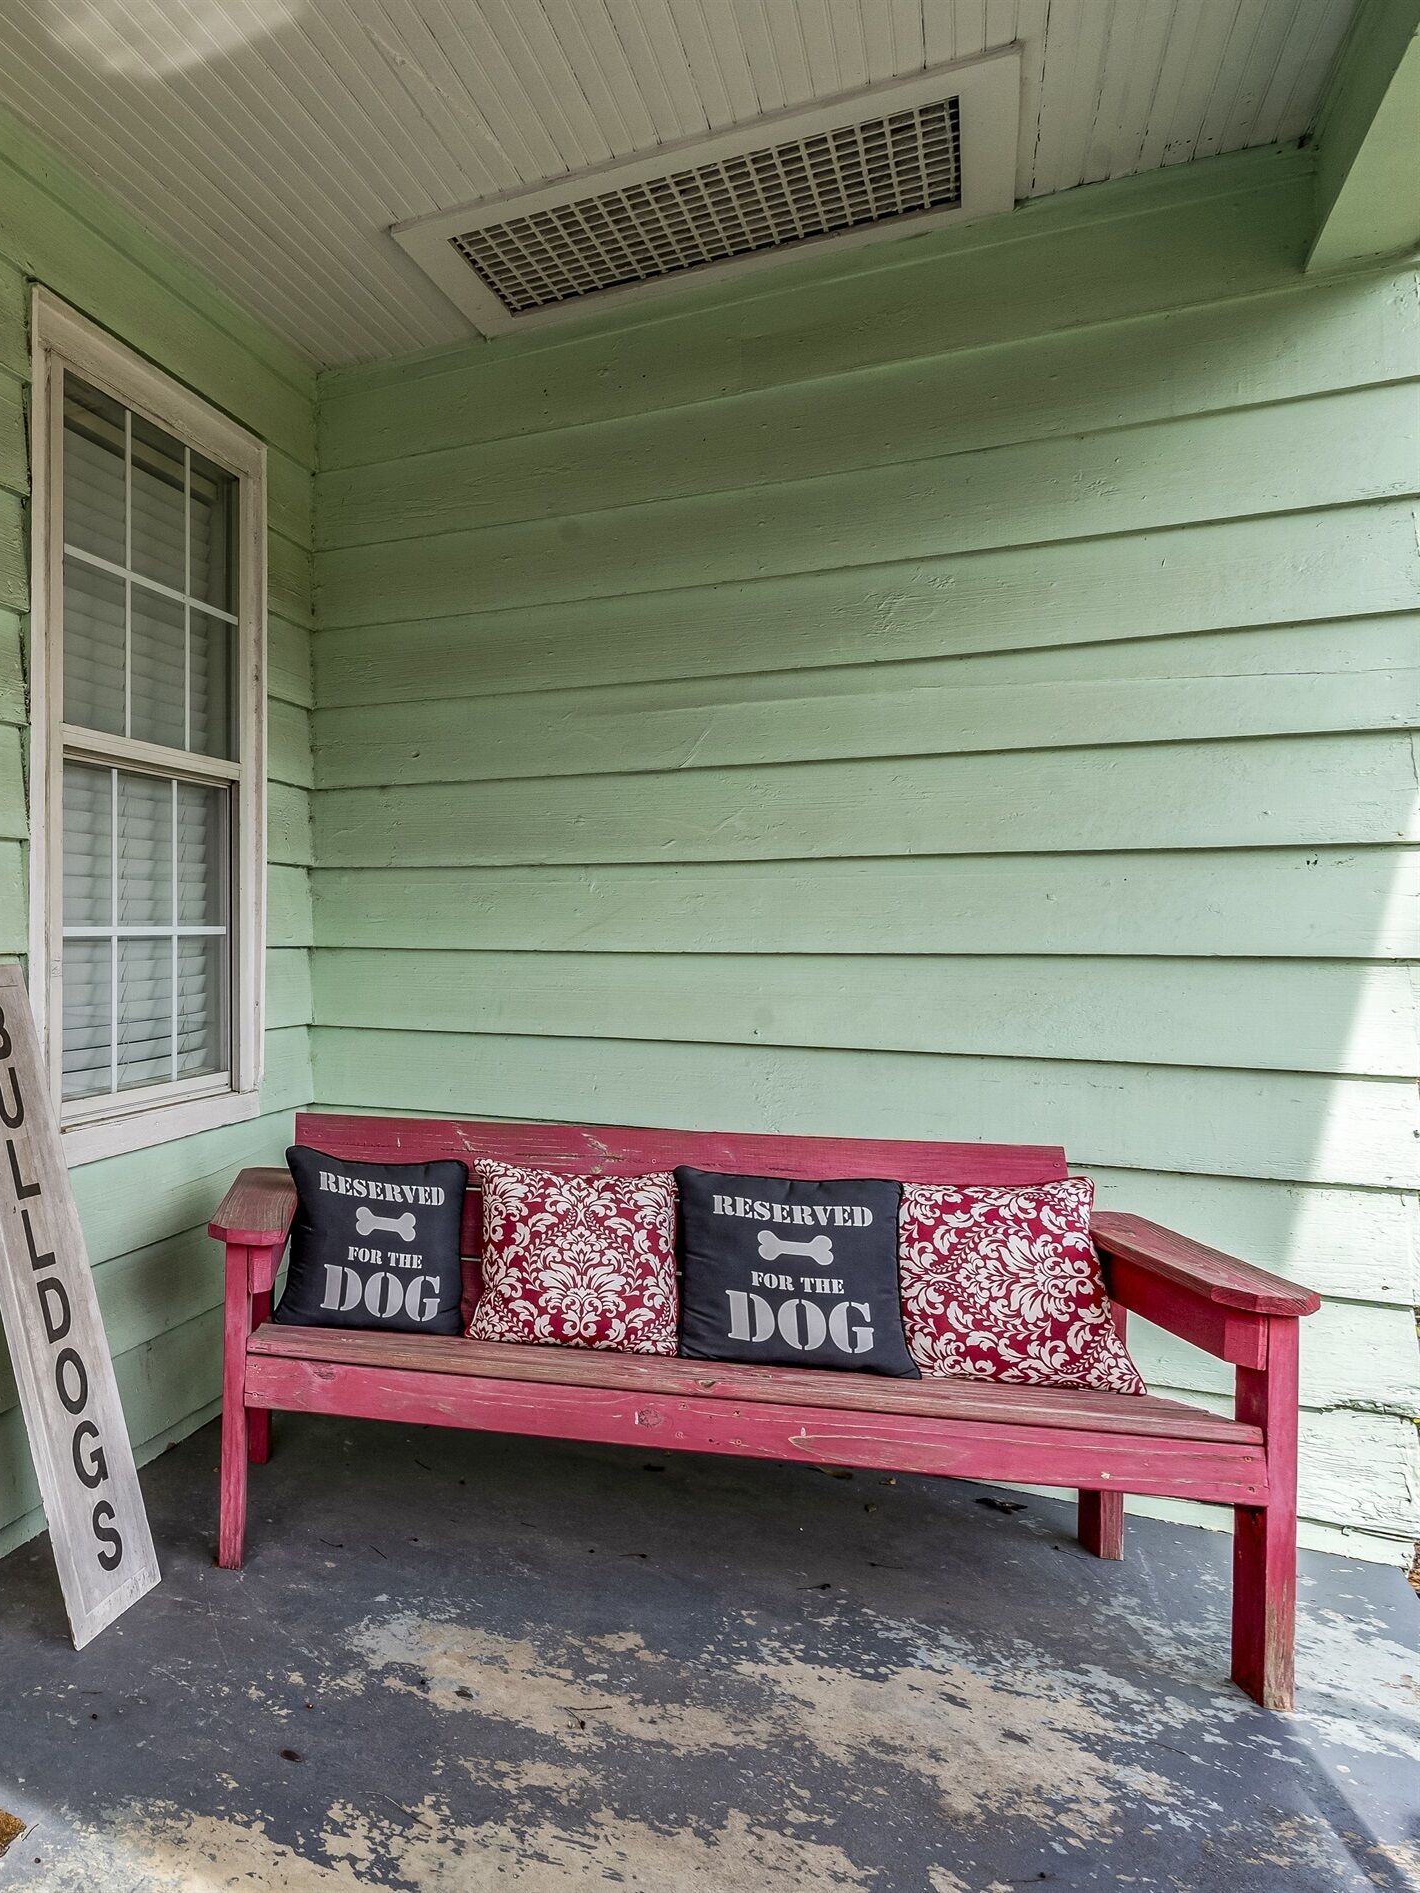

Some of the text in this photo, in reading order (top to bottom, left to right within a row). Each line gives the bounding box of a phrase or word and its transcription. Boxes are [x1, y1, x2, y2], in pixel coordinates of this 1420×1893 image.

[319, 1171, 445, 1206] RESERVED
[712, 1195, 873, 1227] RESERVED
[348, 1246, 422, 1269] FOR THE
[320, 1263, 440, 1322] DOG
[751, 1271, 844, 1294] FOR THE
[725, 1289, 875, 1354] DOG
